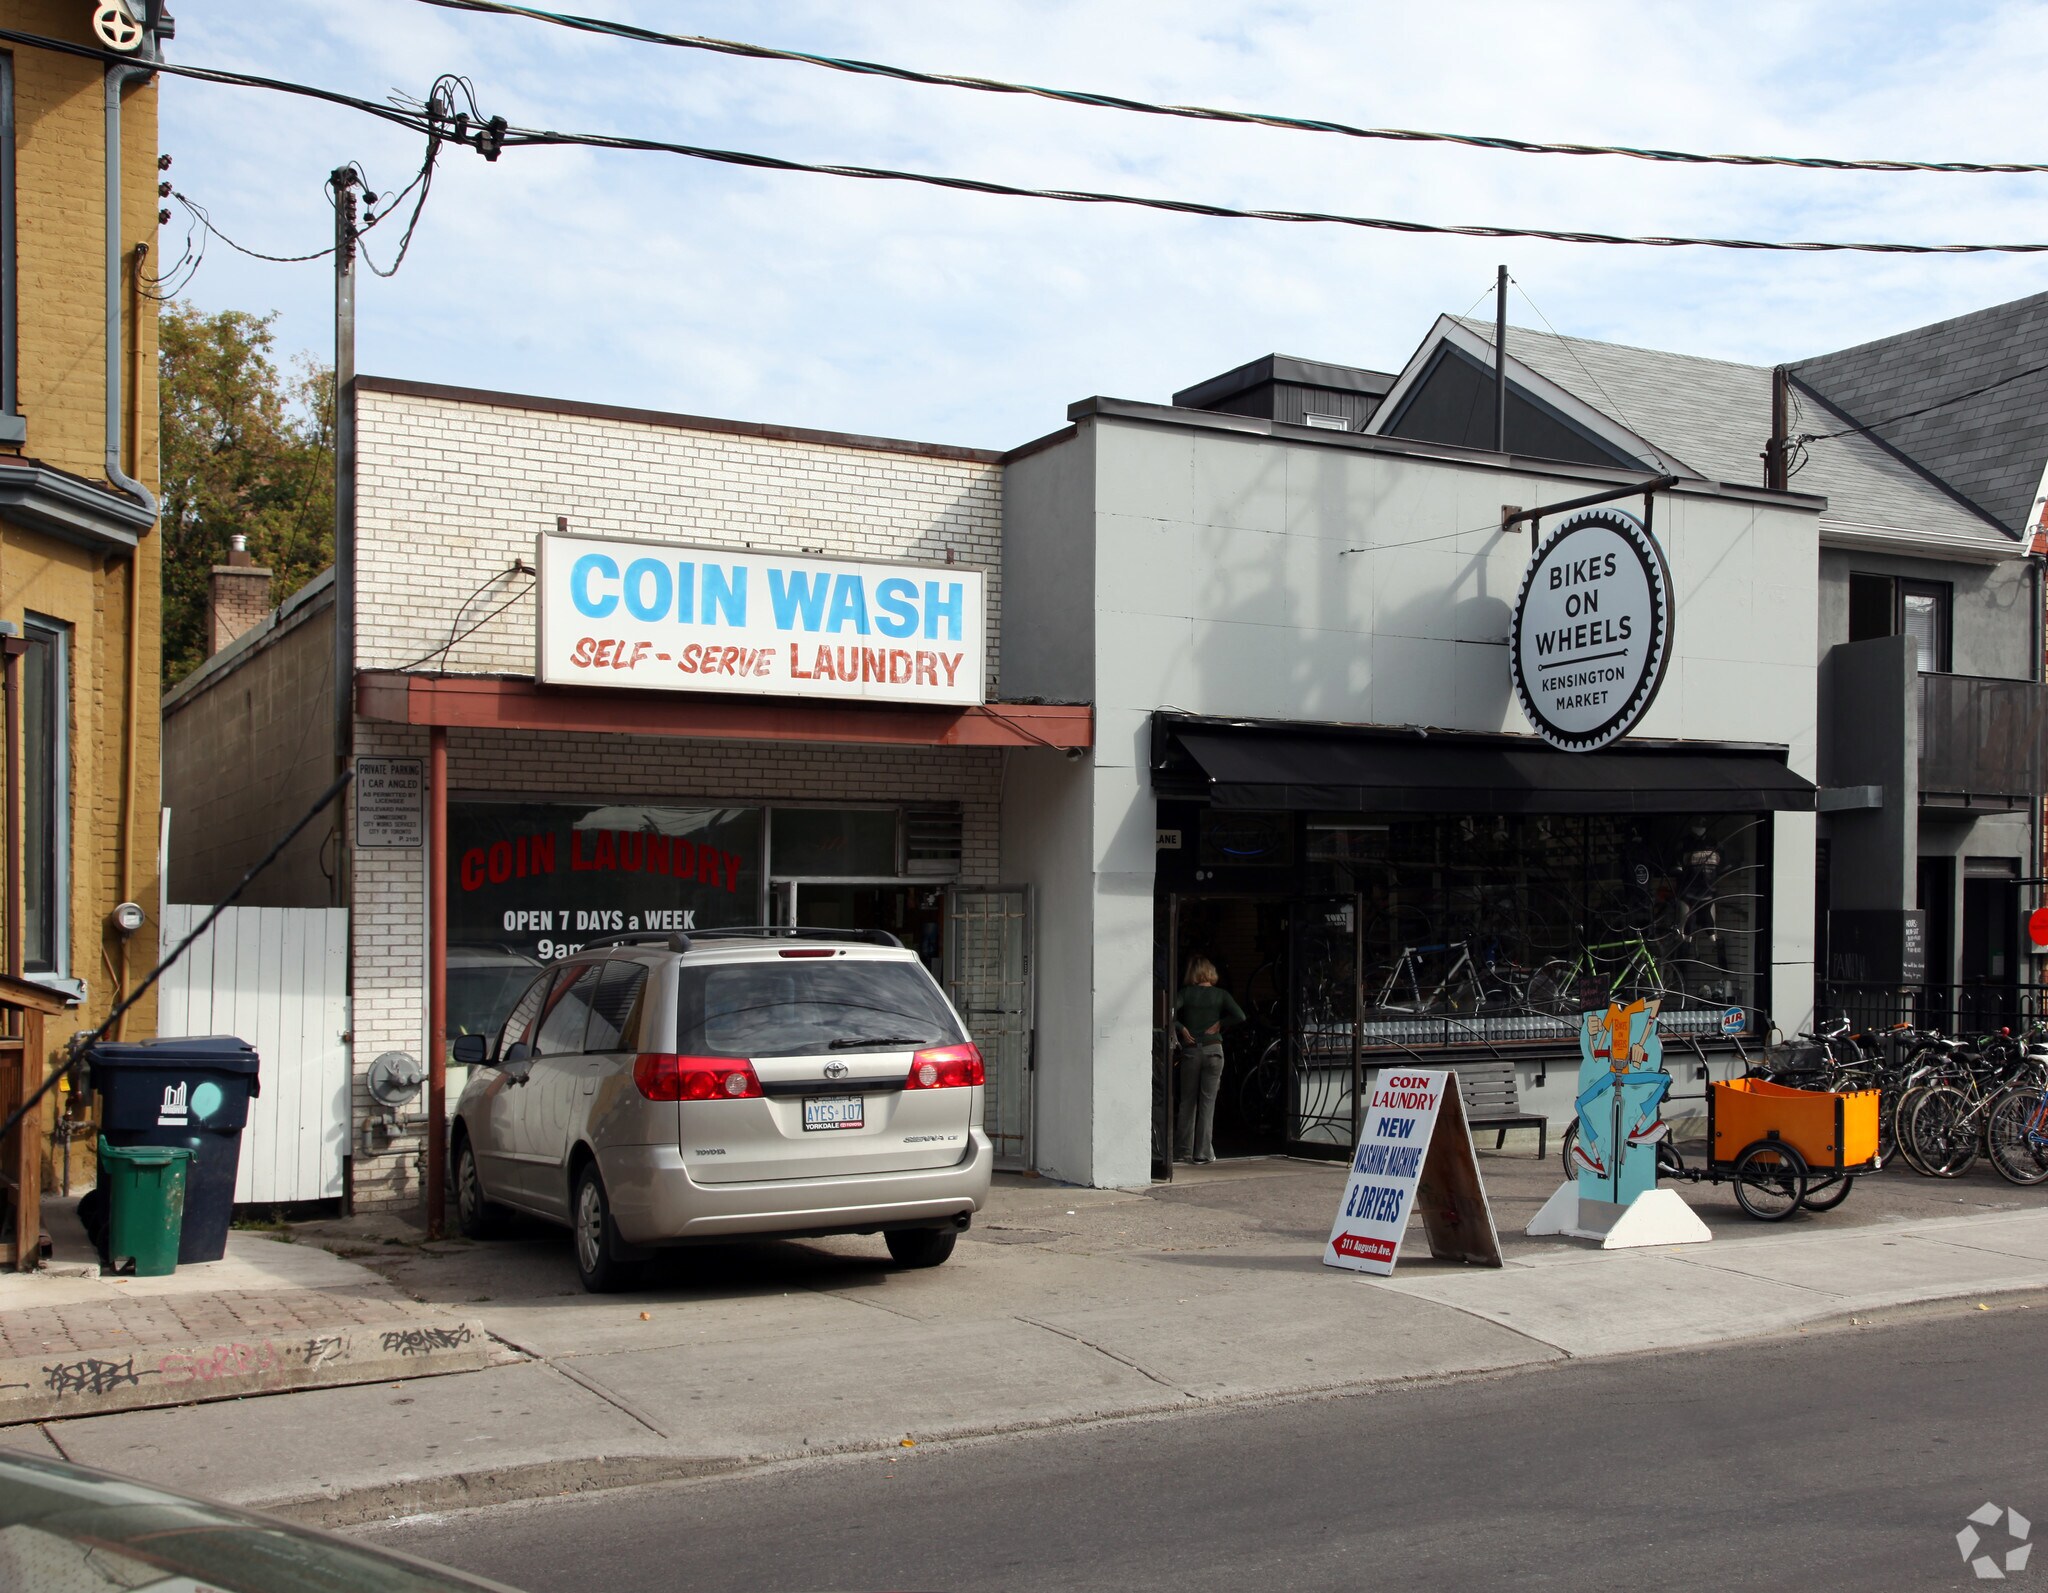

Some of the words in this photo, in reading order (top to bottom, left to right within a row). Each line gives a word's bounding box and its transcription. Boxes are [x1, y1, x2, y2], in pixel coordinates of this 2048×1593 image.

[1549, 552, 1617, 590] BIKES
[570, 553, 748, 628] COIN
[767, 568, 964, 641] WASH
[1565, 588, 1599, 618] ON
[1535, 615, 1632, 656] WHEELS
[790, 642, 965, 687] LAUNDRY
[1542, 666, 1625, 692] KENSINGTON
[1556, 690, 1608, 711] MARKET
[360, 764, 387, 775] PRIVATE
[391, 765, 419, 775] PARKING
[369, 779, 384, 788] CAR
[388, 780, 418, 789] ANGLED
[460, 831, 556, 891] COIN
[571, 828, 742, 894] LAUNDRY
[503, 910, 552, 931] OPEN
[559, 910, 570, 931] 7
[576, 910, 623, 931] DAYS
[628, 914, 640, 930] a
[645, 910, 695, 930] WEEK
[1723, 1012, 1743, 1026] AIR
[1389, 1076, 1431, 1089] COIN
[1372, 1090, 1438, 1111] LAUNDRY
[807, 1105, 834, 1121] AYES
[842, 1103, 862, 1120] 107
[805, 1122, 840, 1130] YORKDALE
[1376, 1116, 1416, 1139] NEW
[1353, 1143, 1390, 1176] WASHING
[1384, 1146, 1423, 1179] MACHINE
[1346, 1184, 1359, 1217] &
[1356, 1185, 1404, 1223] DRYERS
[1341, 1238, 1353, 1250] 311
[1353, 1239, 1378, 1254] Augusta
[1378, 1244, 1392, 1256] Ave.
